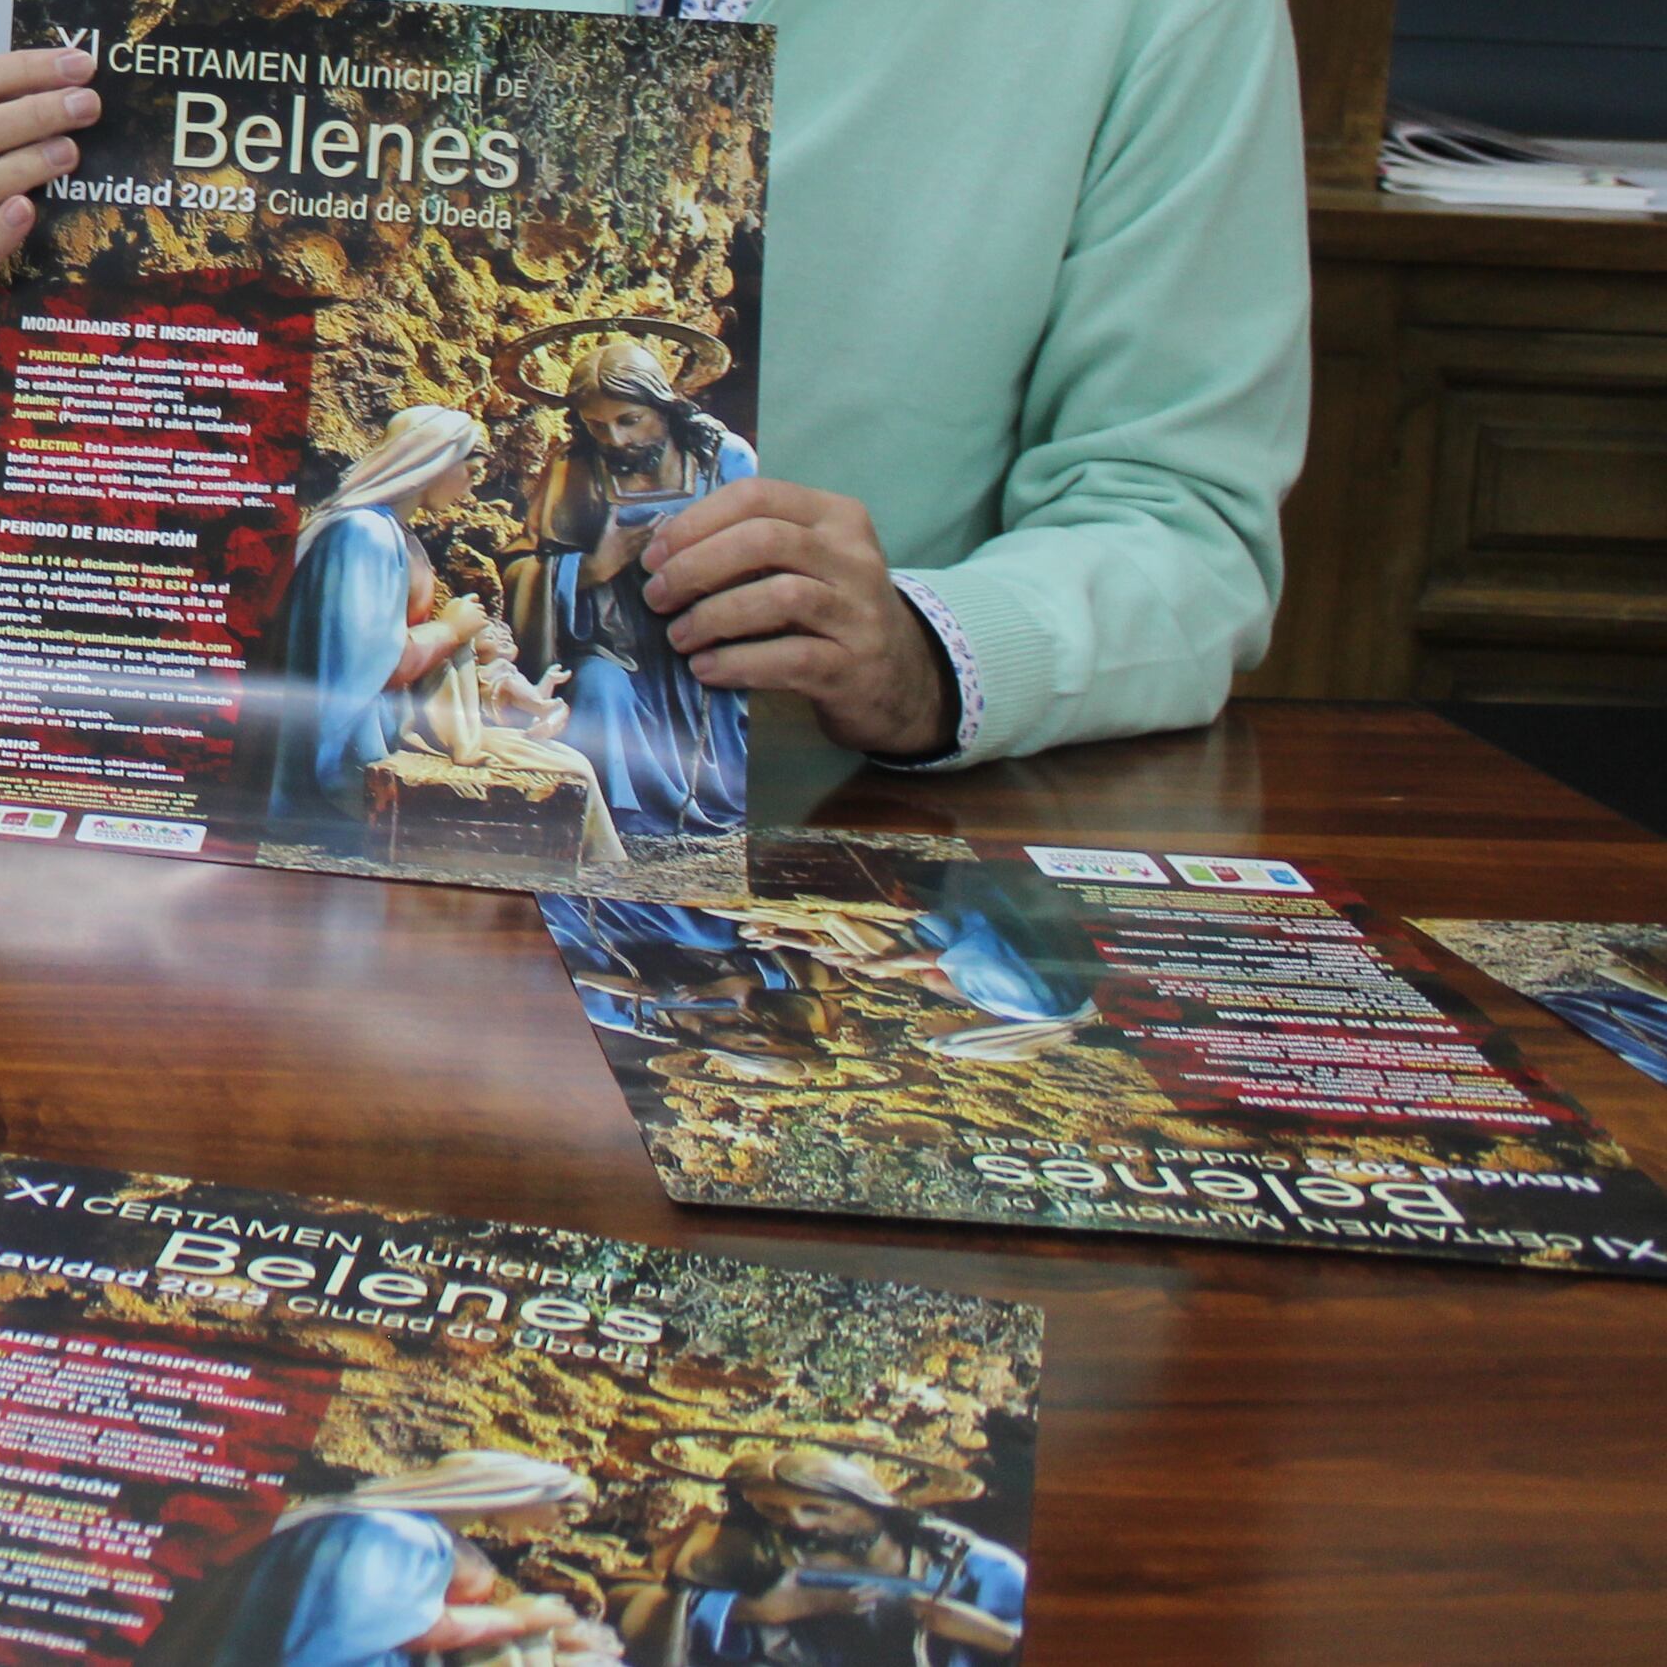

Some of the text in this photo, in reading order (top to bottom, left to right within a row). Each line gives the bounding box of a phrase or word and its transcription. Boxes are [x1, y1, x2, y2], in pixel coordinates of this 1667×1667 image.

[108, 43, 306, 84] CERTAMEN
[319, 58, 481, 100] Municipal
[496, 80, 527, 98] DE
[173, 90, 519, 189] Belenes
[46, 175, 172, 207] Navidad
[181, 183, 256, 212] 2023
[268, 189, 366, 221] Ciudad
[376, 193, 410, 223] de
[21, 316, 259, 346] MODALIDADES DE INSCRIPCIÓN
[19, 439, 248, 464] COLECTIVA: Esta modalidad representa a
[0, 519, 197, 548] PERIODO DE INSCRIPCIÓN
[1099, 1142, 1144, 1160] de
[1157, 1144, 1289, 1170] Ciudad
[1304, 1156, 1406, 1179] 2023
[972, 1155, 1465, 1225] Belenes
[1421, 1164, 1601, 1194] Navidad
[1056, 1200, 1283, 1232] Municipal
[1301, 1214, 1582, 1249] CERTAMEN
[5, 1177, 76, 1208] XI
[81, 1196, 362, 1254] CERTAMEN
[377, 1238, 612, 1292] Municipal
[155, 1230, 665, 1345] Belenes
[156, 1274, 271, 1308] 2023
[286, 1294, 435, 1335] Ciudad
[446, 1316, 498, 1344] de
[65, 1341, 98, 1357] DE
[99, 1345, 251, 1380] INSCRIPCIÓN
